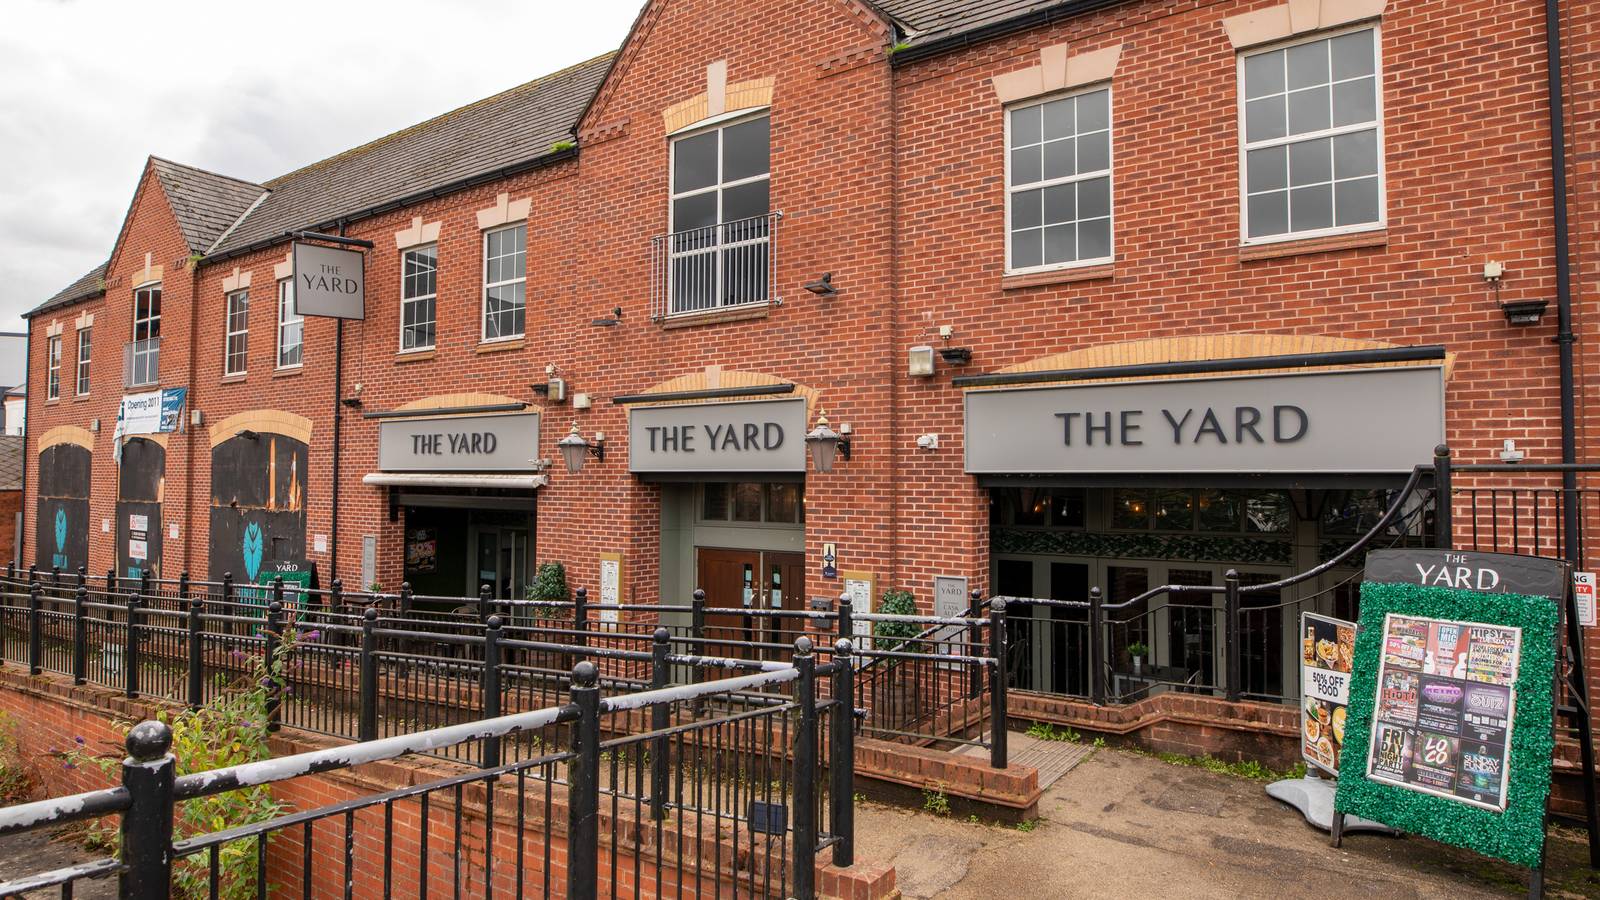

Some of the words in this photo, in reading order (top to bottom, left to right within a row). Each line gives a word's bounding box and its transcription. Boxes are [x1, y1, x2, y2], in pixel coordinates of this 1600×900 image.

[320, 264, 342, 275] THE
[303, 273, 358, 294] YARD
[1054, 410, 1143, 446] THE
[1161, 405, 1309, 444] YARD
[411, 434, 443, 455] THE
[447, 432, 497, 454] YARD
[645, 425, 696, 452] THE
[704, 422, 785, 451] YARD
[1445, 553, 1468, 563] THE
[276, 564, 298, 572] YARD
[1416, 563, 1500, 590] YARD
[941, 587, 962, 595] YARD
[1473, 628, 1502, 639] TIPSY
[1313, 672, 1327, 685] 50%
[1329, 675, 1344, 688] OFF
[1318, 684, 1338, 697] FOOD
[1382, 728, 1406, 745] FRI
[1381, 742, 1404, 756] DAY
[1380, 751, 1403, 762] NIGHT
[1463, 754, 1500, 766] SUNDAY
[1379, 758, 1403, 770] PARTY
